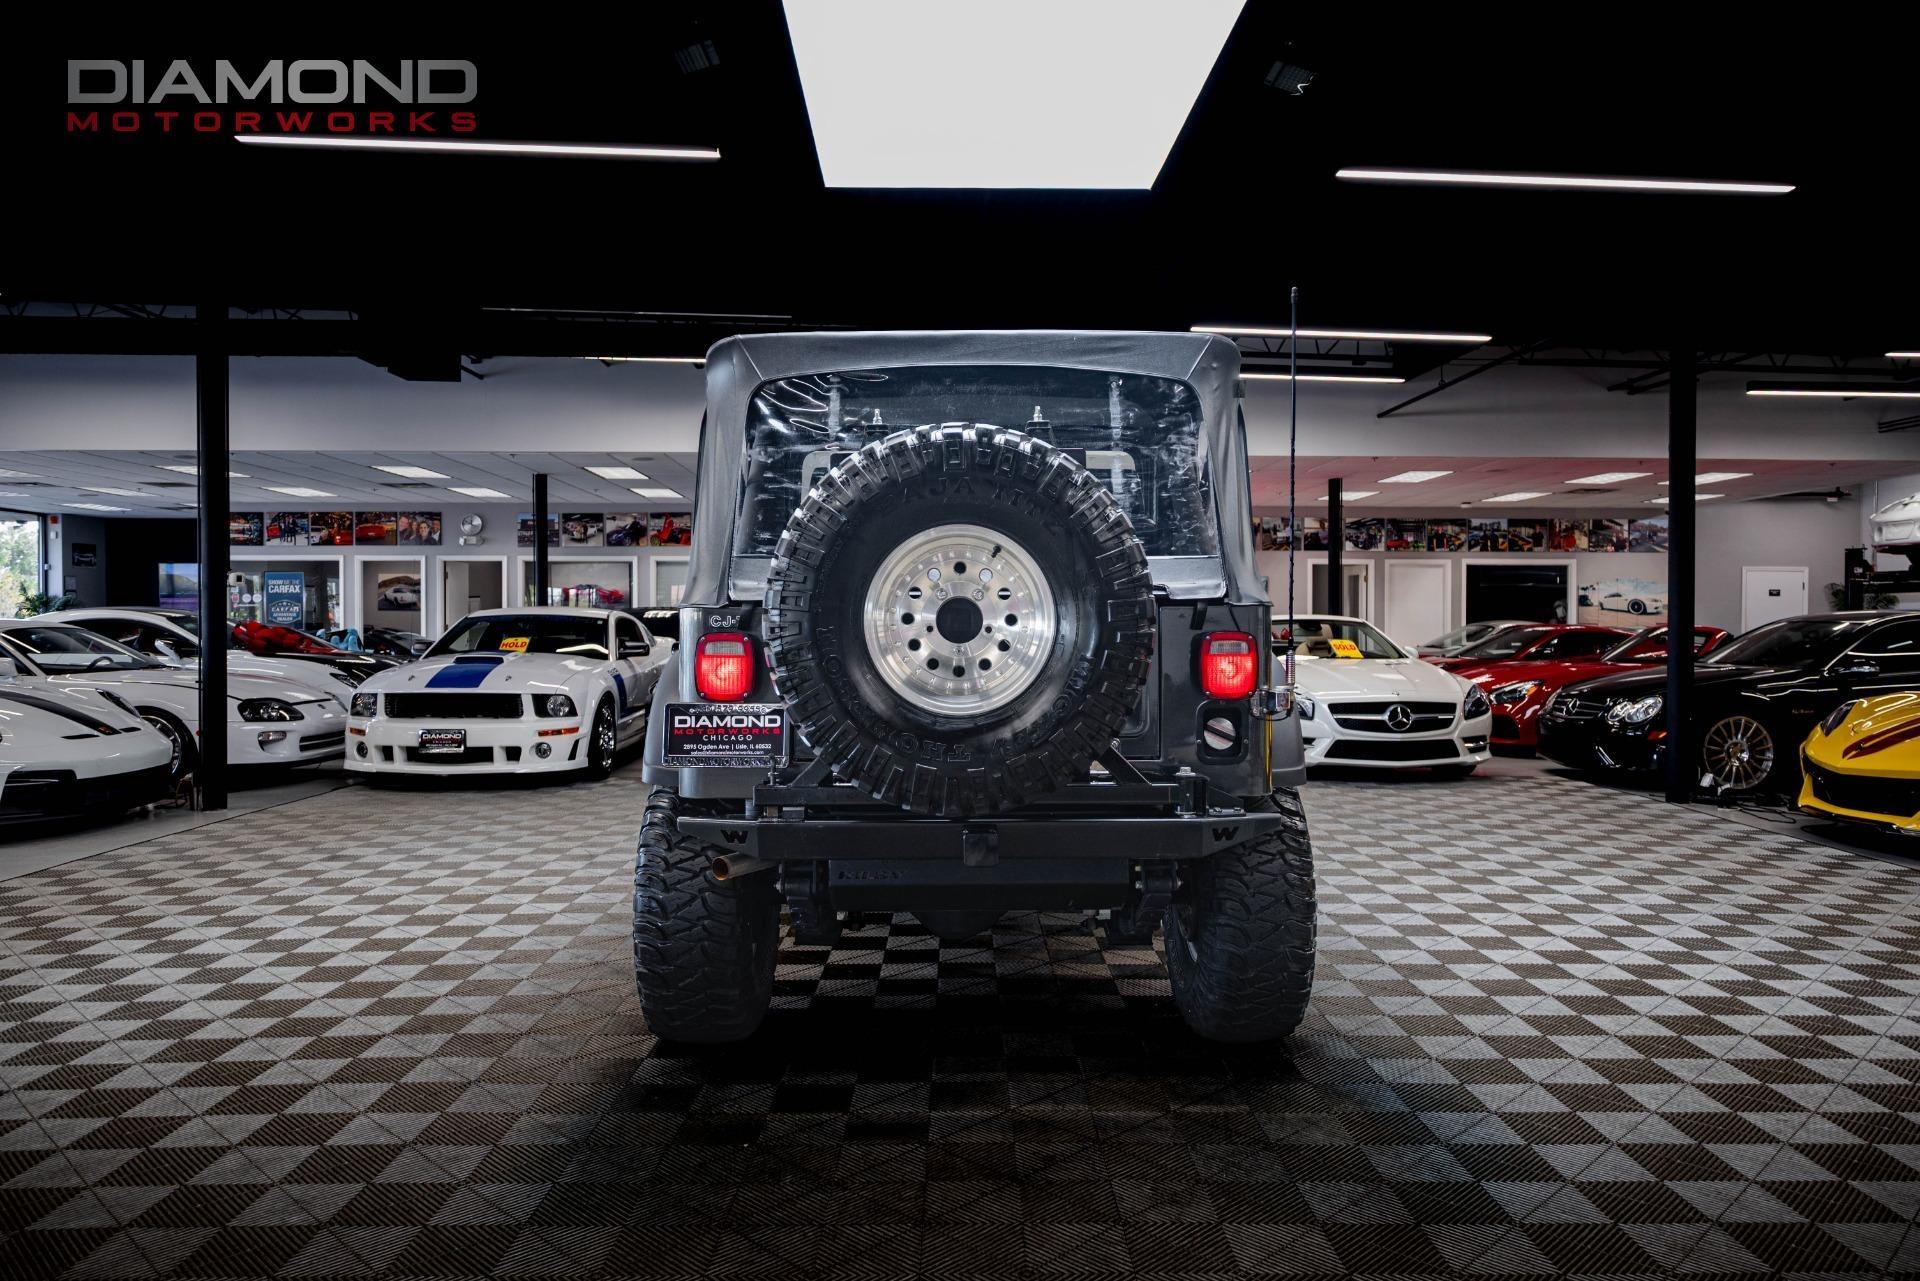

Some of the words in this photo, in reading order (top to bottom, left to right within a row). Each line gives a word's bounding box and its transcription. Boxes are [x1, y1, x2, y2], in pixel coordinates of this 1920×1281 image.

[268, 585, 301, 593] CARFAX
[501, 641, 527, 649] HOLD
[674, 715, 781, 728] DIAMOND
[698, 743, 718, 751] Ogden
